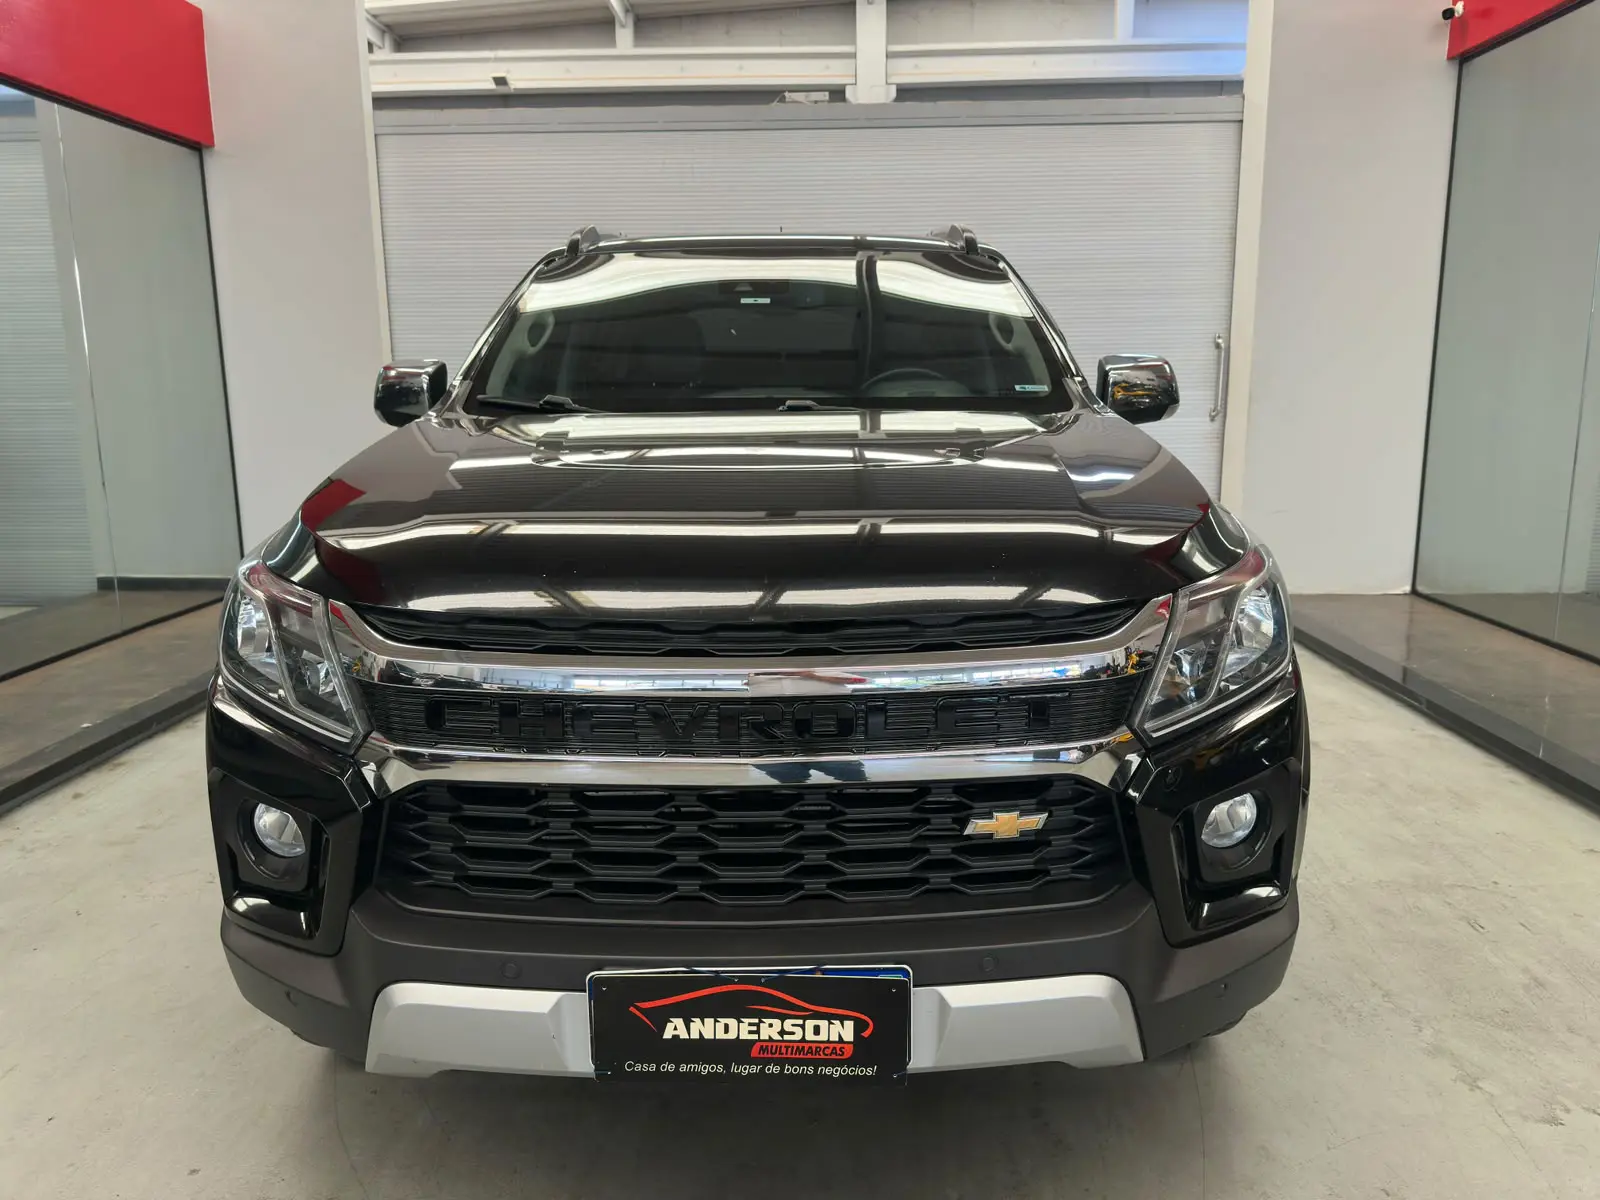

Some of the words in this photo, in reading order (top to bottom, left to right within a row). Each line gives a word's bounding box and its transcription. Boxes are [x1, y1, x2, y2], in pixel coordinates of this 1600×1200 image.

[425, 691, 1071, 741] CHEVROLET
[662, 1017, 854, 1042] ANDERSON
[757, 1044, 846, 1057] MULTIMARCAS
[624, 1061, 655, 1072] Casa
[660, 1061, 676, 1072] de
[679, 1062, 727, 1076] amigos,
[731, 1062, 762, 1076] lugar
[765, 1063, 781, 1074] de
[784, 1063, 814, 1075] bons
[817, 1063, 878, 1077] negócios!
